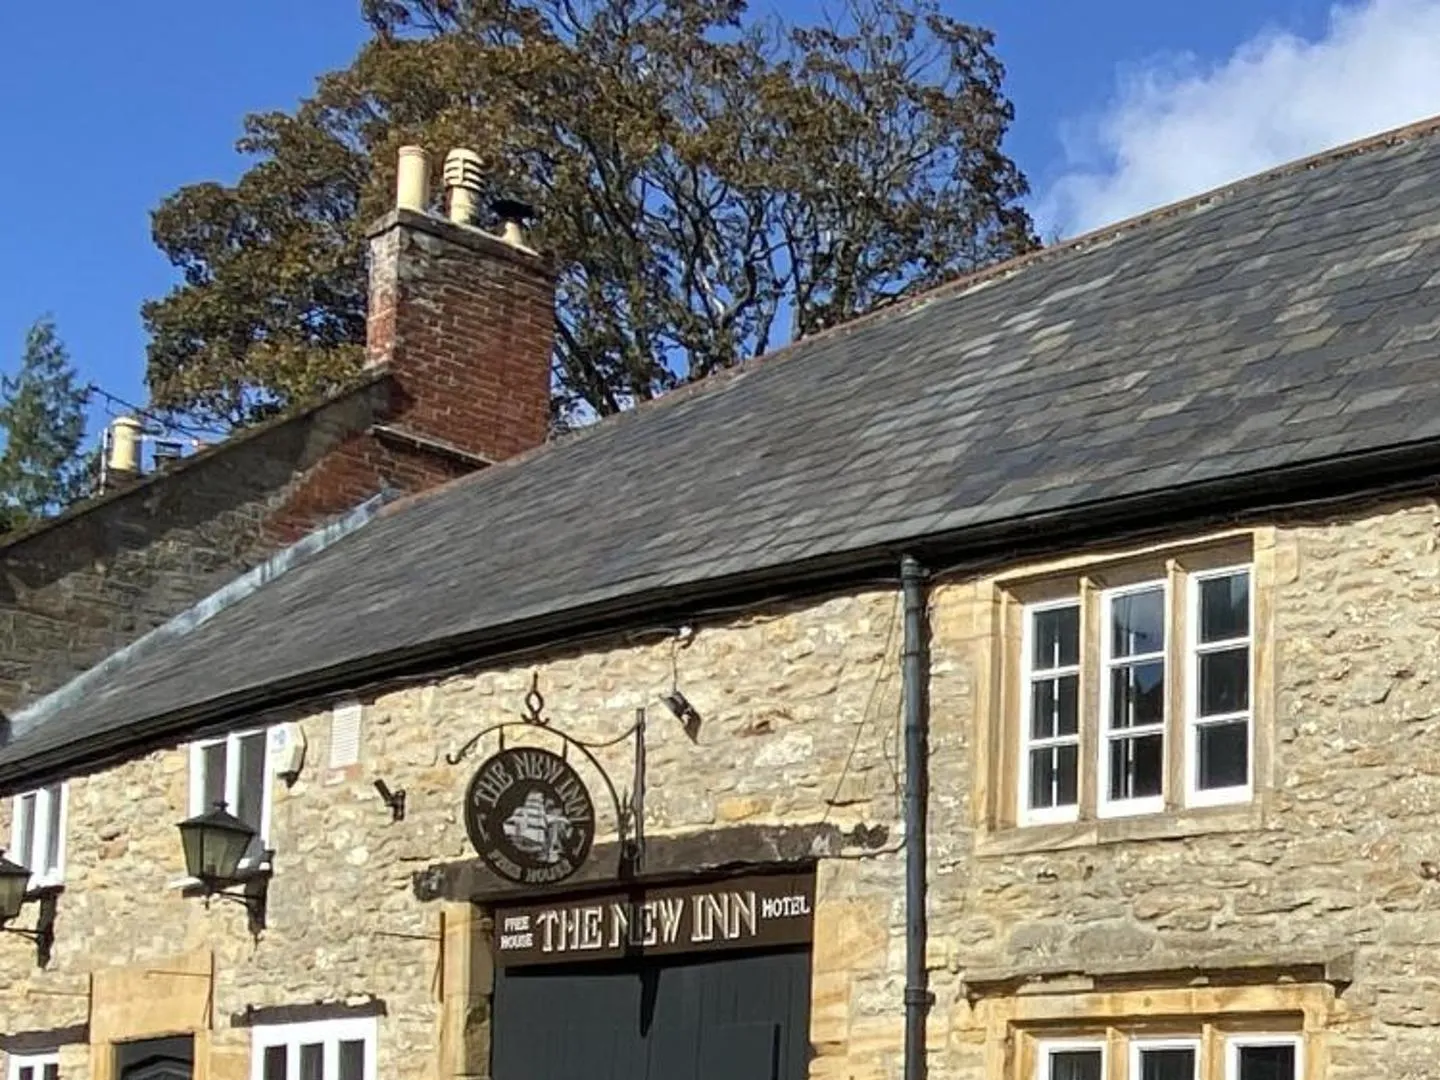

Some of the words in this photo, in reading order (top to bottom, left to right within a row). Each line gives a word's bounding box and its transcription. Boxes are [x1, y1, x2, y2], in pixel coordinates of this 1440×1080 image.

[474, 761, 513, 808] THE
[513, 752, 564, 784] NEW
[554, 777, 591, 821] INN
[762, 895, 811, 918] HOTEL
[504, 916, 530, 932] FREE
[536, 907, 602, 952] THE
[608, 900, 683, 948] NEW
[691, 891, 757, 942] INN
[500, 933, 533, 949] HOUSE
